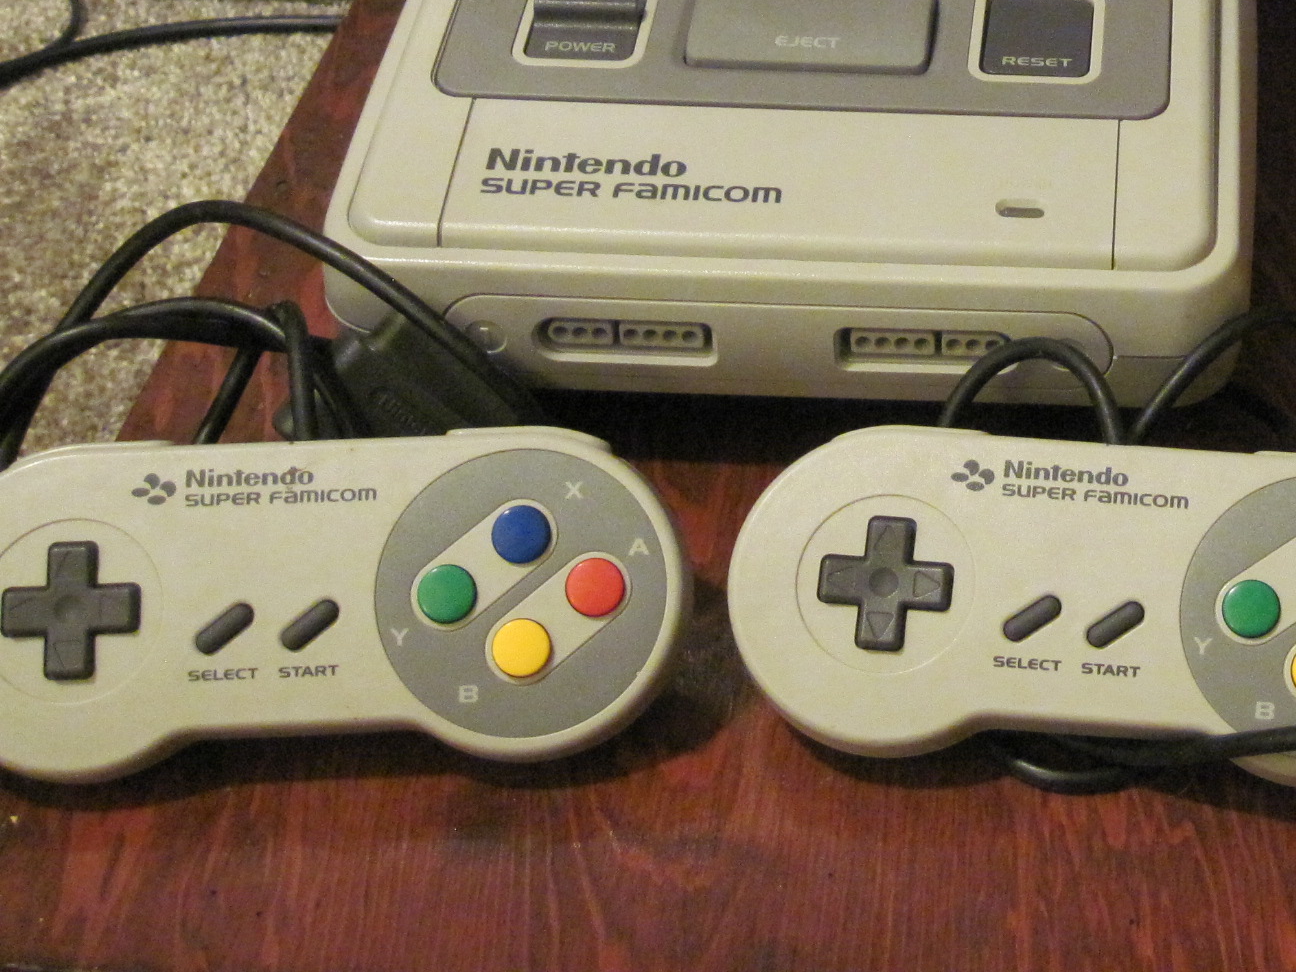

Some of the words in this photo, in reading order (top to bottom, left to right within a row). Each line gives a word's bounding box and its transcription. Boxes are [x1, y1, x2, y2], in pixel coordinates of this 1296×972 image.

[545, 41, 616, 53] POWER
[775, 35, 840, 49] EJECT
[1002, 55, 1072, 69] RESET
[486, 148, 687, 178] Nintendo
[480, 177, 599, 199] SUPER
[185, 467, 314, 488] Nintendo
[1003, 460, 1129, 486] Nintendo
[184, 489, 261, 506] SUPER
[565, 480, 584, 499] X
[1001, 484, 1076, 502] SUPER
[628, 539, 650, 556] A
[390, 629, 408, 646] Y
[1193, 638, 1211, 655] Y
[278, 664, 341, 679] START
[993, 656, 1062, 671] SELECT
[1081, 663, 1141, 678] START
[187, 667, 258, 683] SELECT
[458, 685, 478, 703] B
[1255, 702, 1274, 720] B
